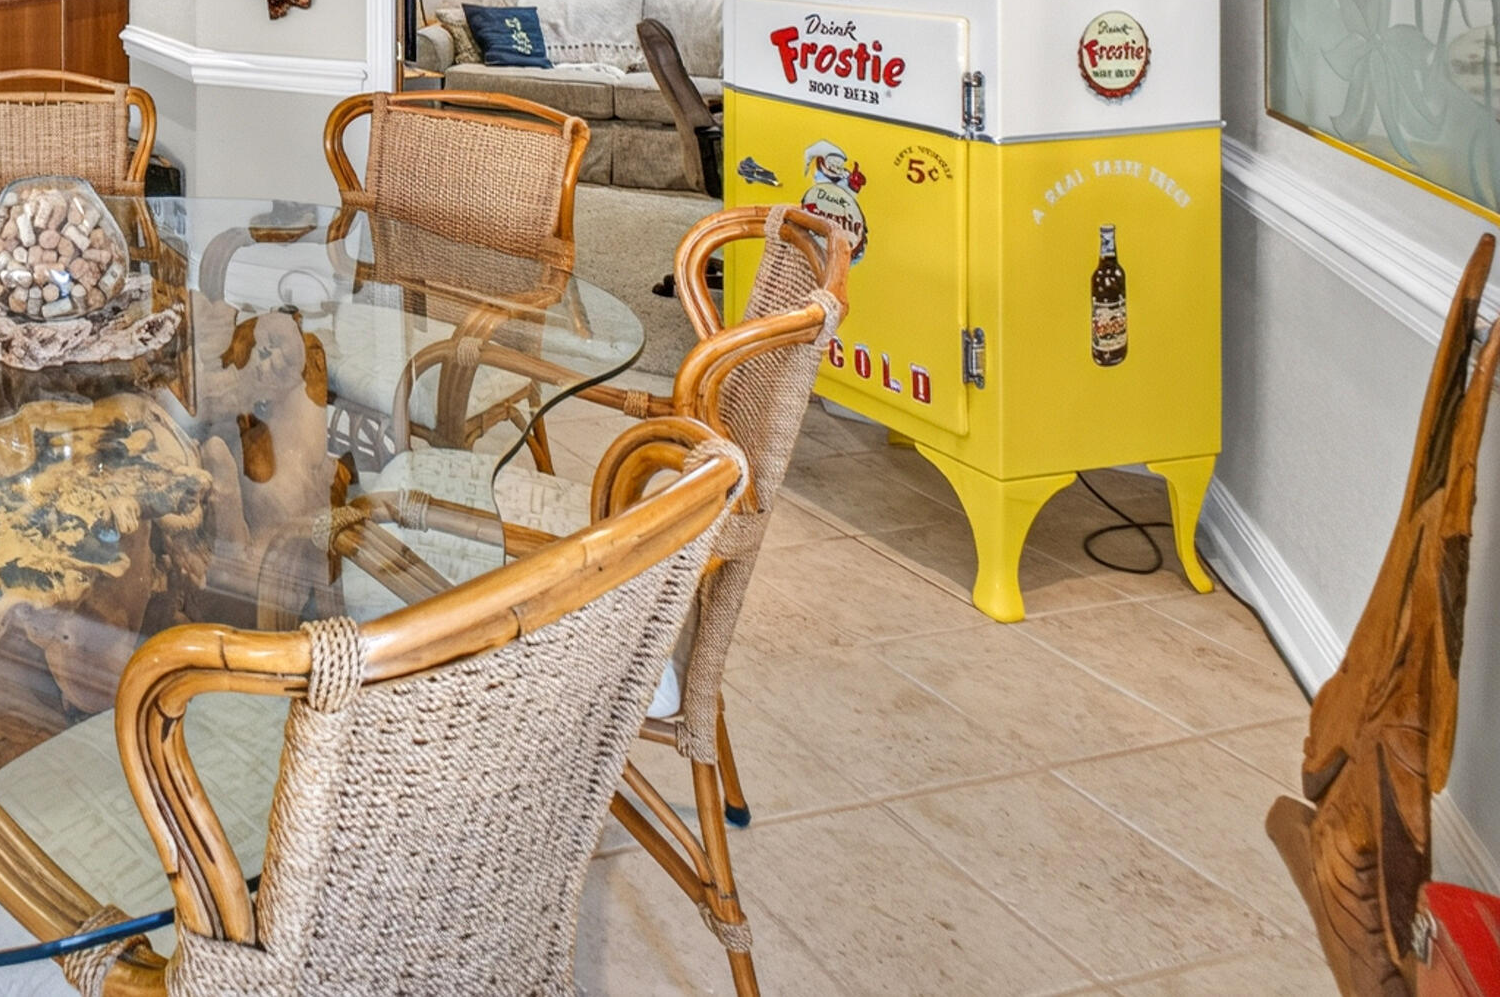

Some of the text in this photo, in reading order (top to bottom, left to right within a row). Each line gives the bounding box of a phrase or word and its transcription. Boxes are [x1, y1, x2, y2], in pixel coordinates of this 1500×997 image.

[805, 13, 857, 41] Drink
[770, 26, 906, 88] Frostie
[1083, 39, 1145, 68] Frostie
[808, 79, 879, 104] ROOT BEER
[829, 337, 931, 404] COLD
